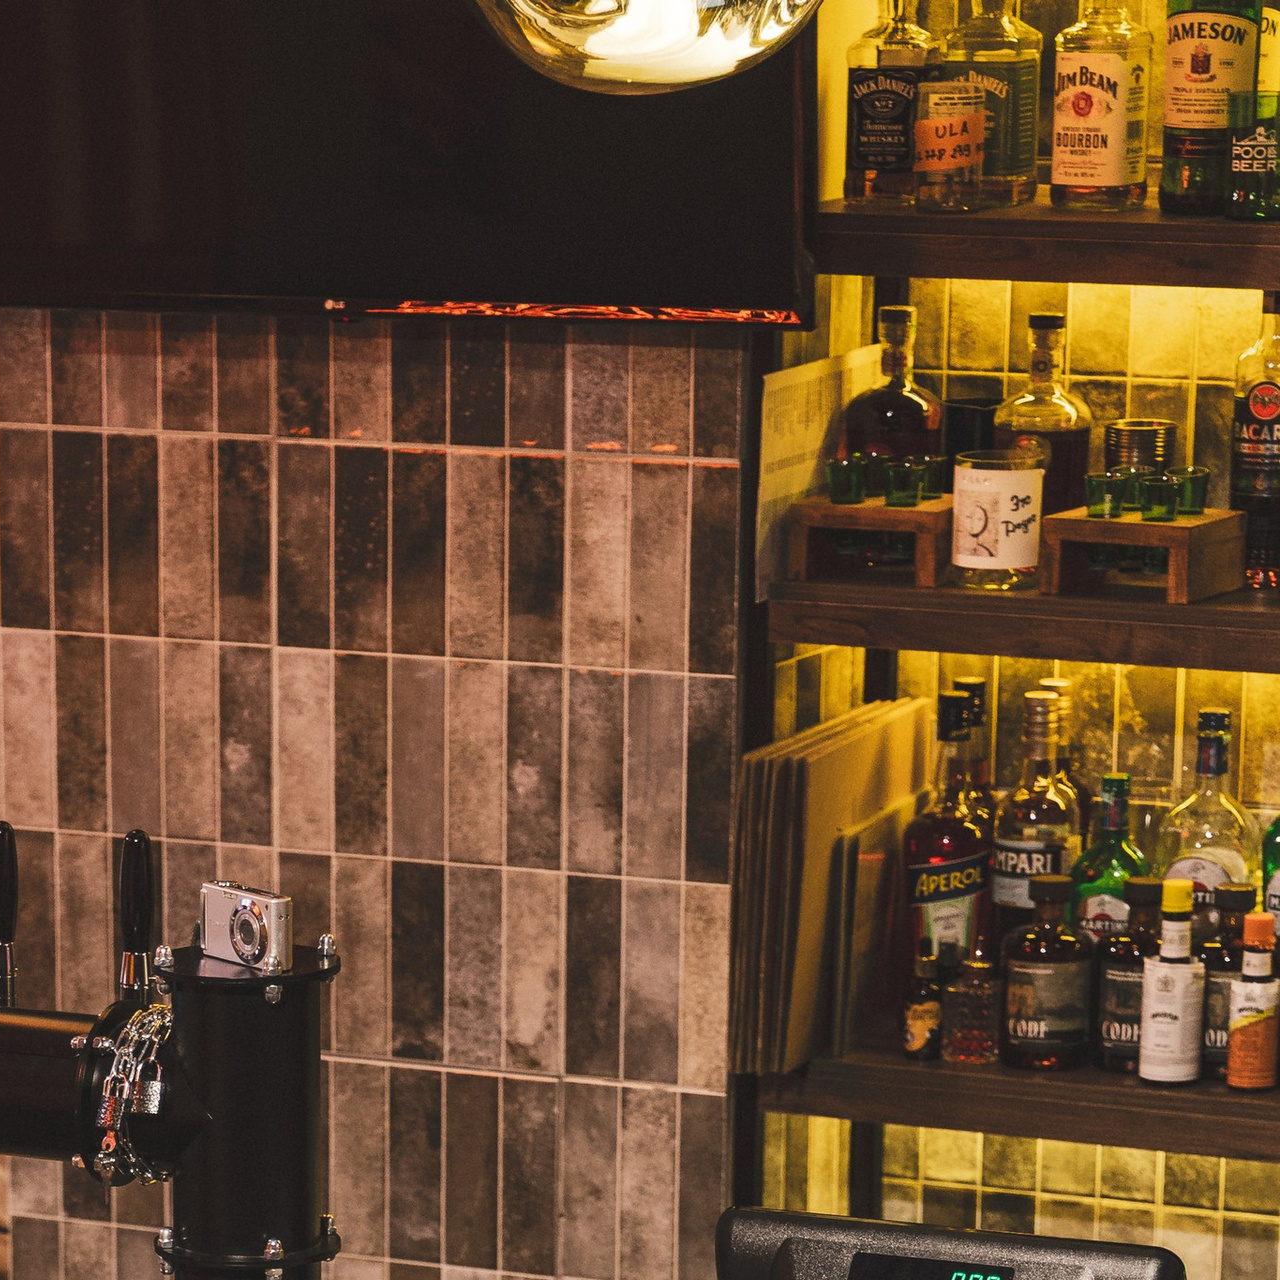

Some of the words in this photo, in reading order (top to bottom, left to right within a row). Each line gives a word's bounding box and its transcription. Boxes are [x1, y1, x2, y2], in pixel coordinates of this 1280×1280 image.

[1168, 22, 1247, 46] JAMESON
[853, 79, 877, 98] JACK
[1055, 72, 1077, 96] JIM
[1080, 66, 1118, 99] BEAM
[1056, 132, 1108, 149] BOURBON
[1231, 159, 1278, 172] BEER
[996, 851, 1053, 875] MPARI
[915, 866, 984, 897] APEROL
